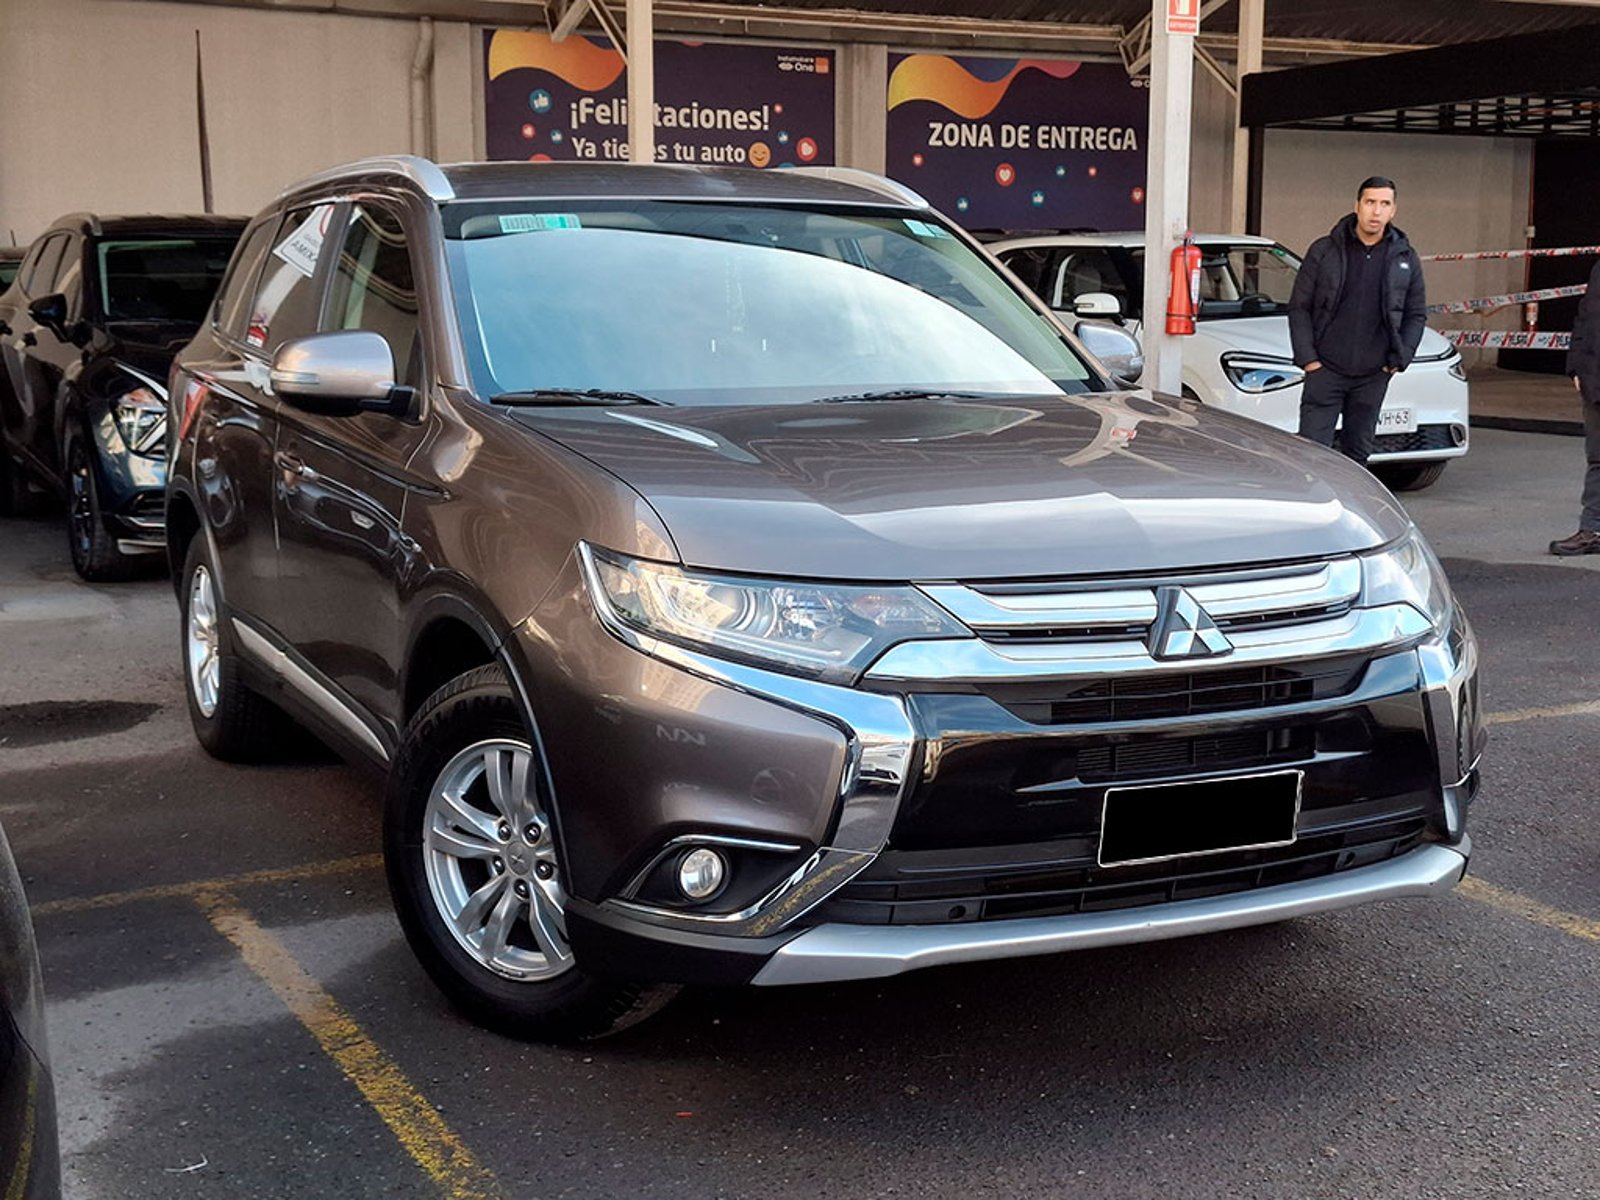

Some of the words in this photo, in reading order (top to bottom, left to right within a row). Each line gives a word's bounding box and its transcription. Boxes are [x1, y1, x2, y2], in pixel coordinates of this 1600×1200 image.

[570, 98, 769, 130] ¡Felitaciones!
[571, 137, 597, 158] Ya
[602, 139, 668, 161] ties
[673, 142, 695, 161] tu
[700, 145, 746, 163] auto
[928, 122, 994, 148] ZONA
[1001, 124, 1030, 148] DE
[1037, 125, 1138, 151] ENTREGA
